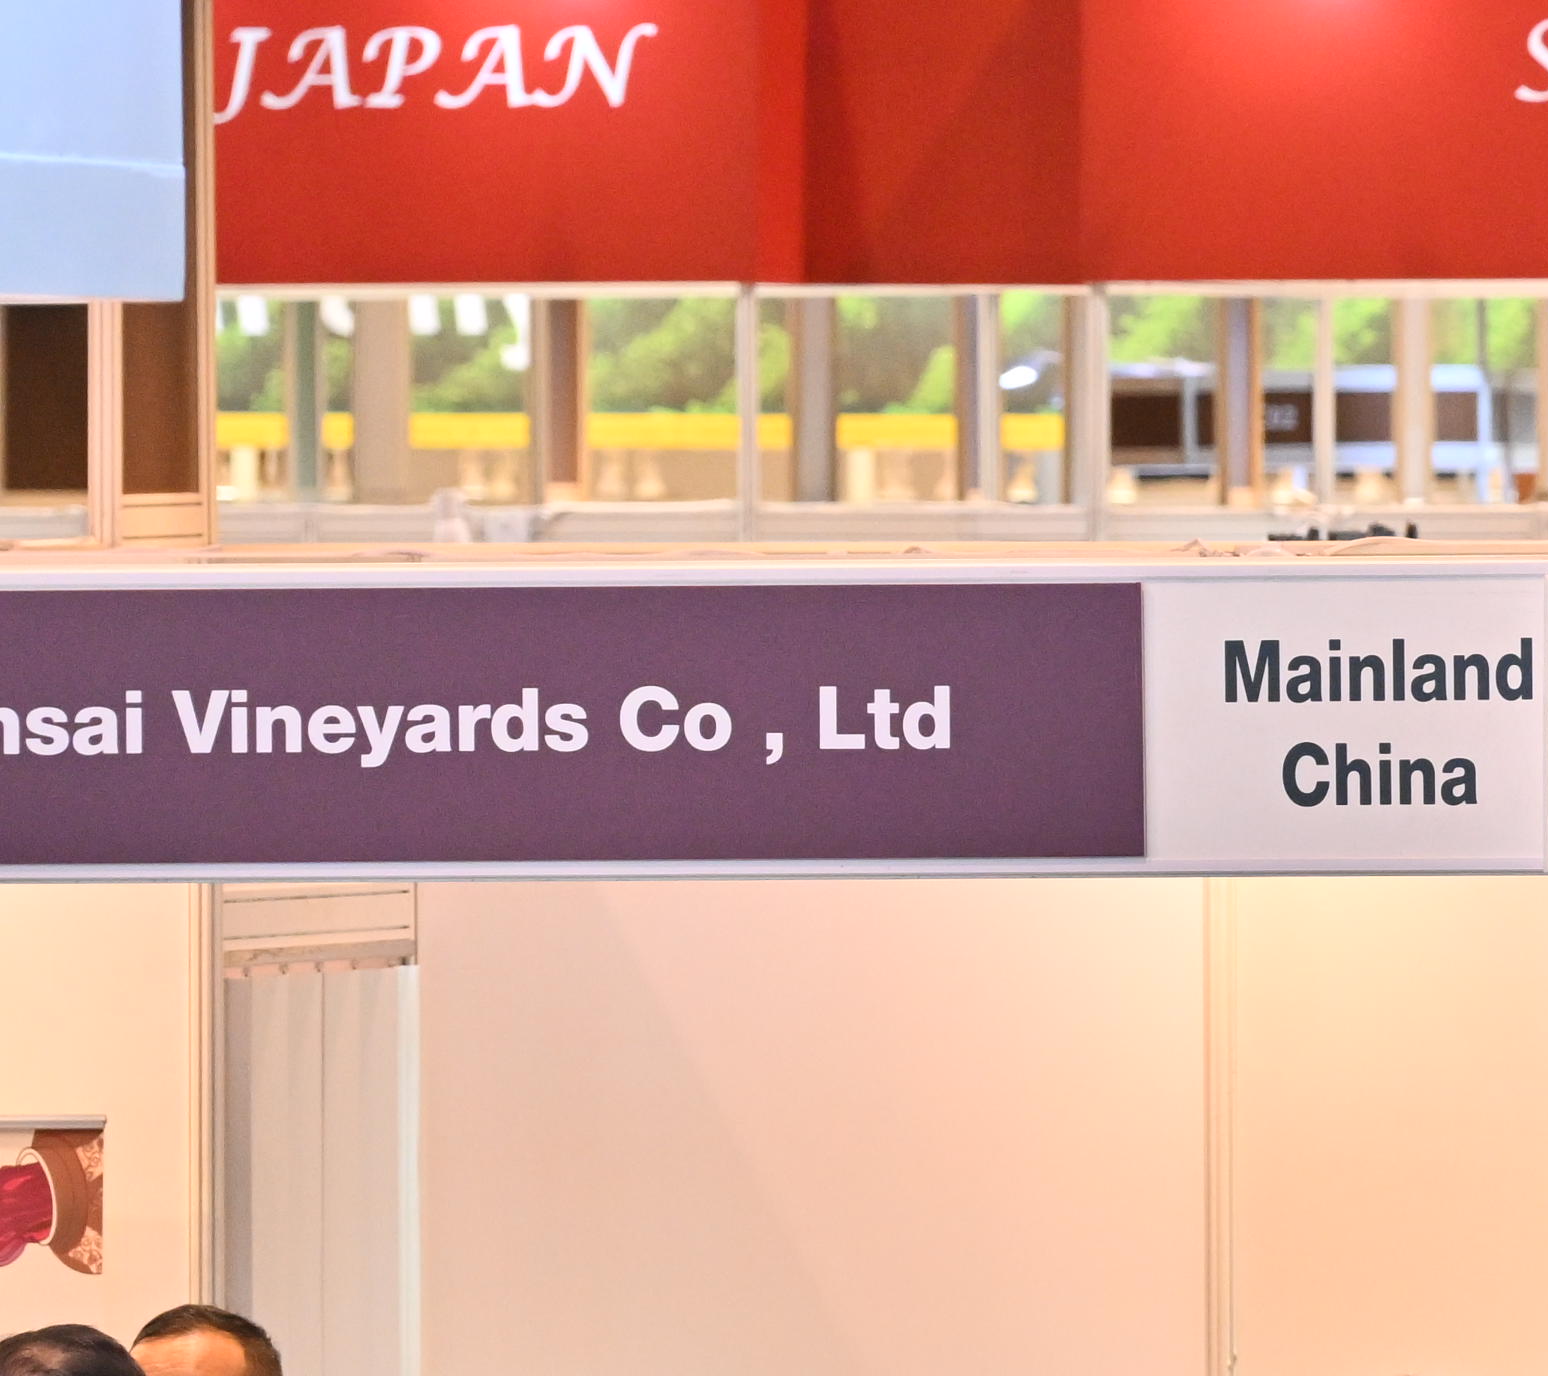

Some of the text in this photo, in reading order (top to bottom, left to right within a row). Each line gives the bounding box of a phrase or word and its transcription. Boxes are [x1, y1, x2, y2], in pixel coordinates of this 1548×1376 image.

[213, 23, 658, 125] JAPAN
[1224, 637, 1534, 703] Mainland
[171, 687, 589, 769] Vineyards
[619, 685, 733, 753] Co
[818, 684, 952, 751] Ltd
[1281, 741, 1479, 807] China
